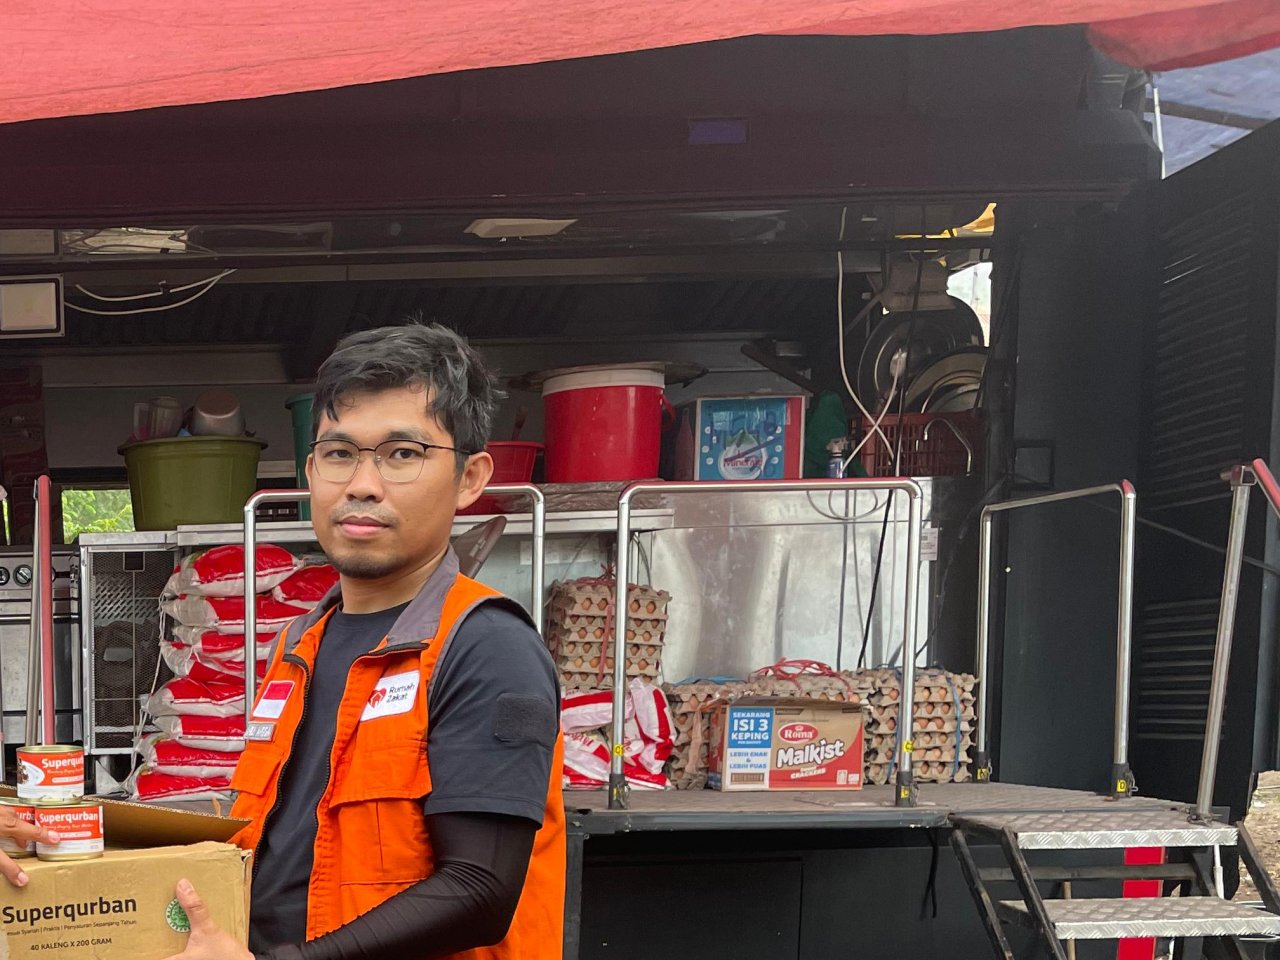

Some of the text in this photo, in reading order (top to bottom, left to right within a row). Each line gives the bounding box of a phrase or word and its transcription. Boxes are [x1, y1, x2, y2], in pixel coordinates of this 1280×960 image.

[389, 683, 415, 693] Rumah
[386, 692, 408, 703] Zakat
[733, 719, 768, 731] ISI 3
[731, 732, 769, 740] KEPING
[784, 729, 813, 739] Roma
[776, 739, 845, 768] Malkist
[39, 812, 99, 824] Superqurban
[2, 896, 137, 926] Superqurban
[41, 942, 69, 950] KALENG
[76, 939, 90, 947] 200
[91, 938, 112, 946] GRAM
